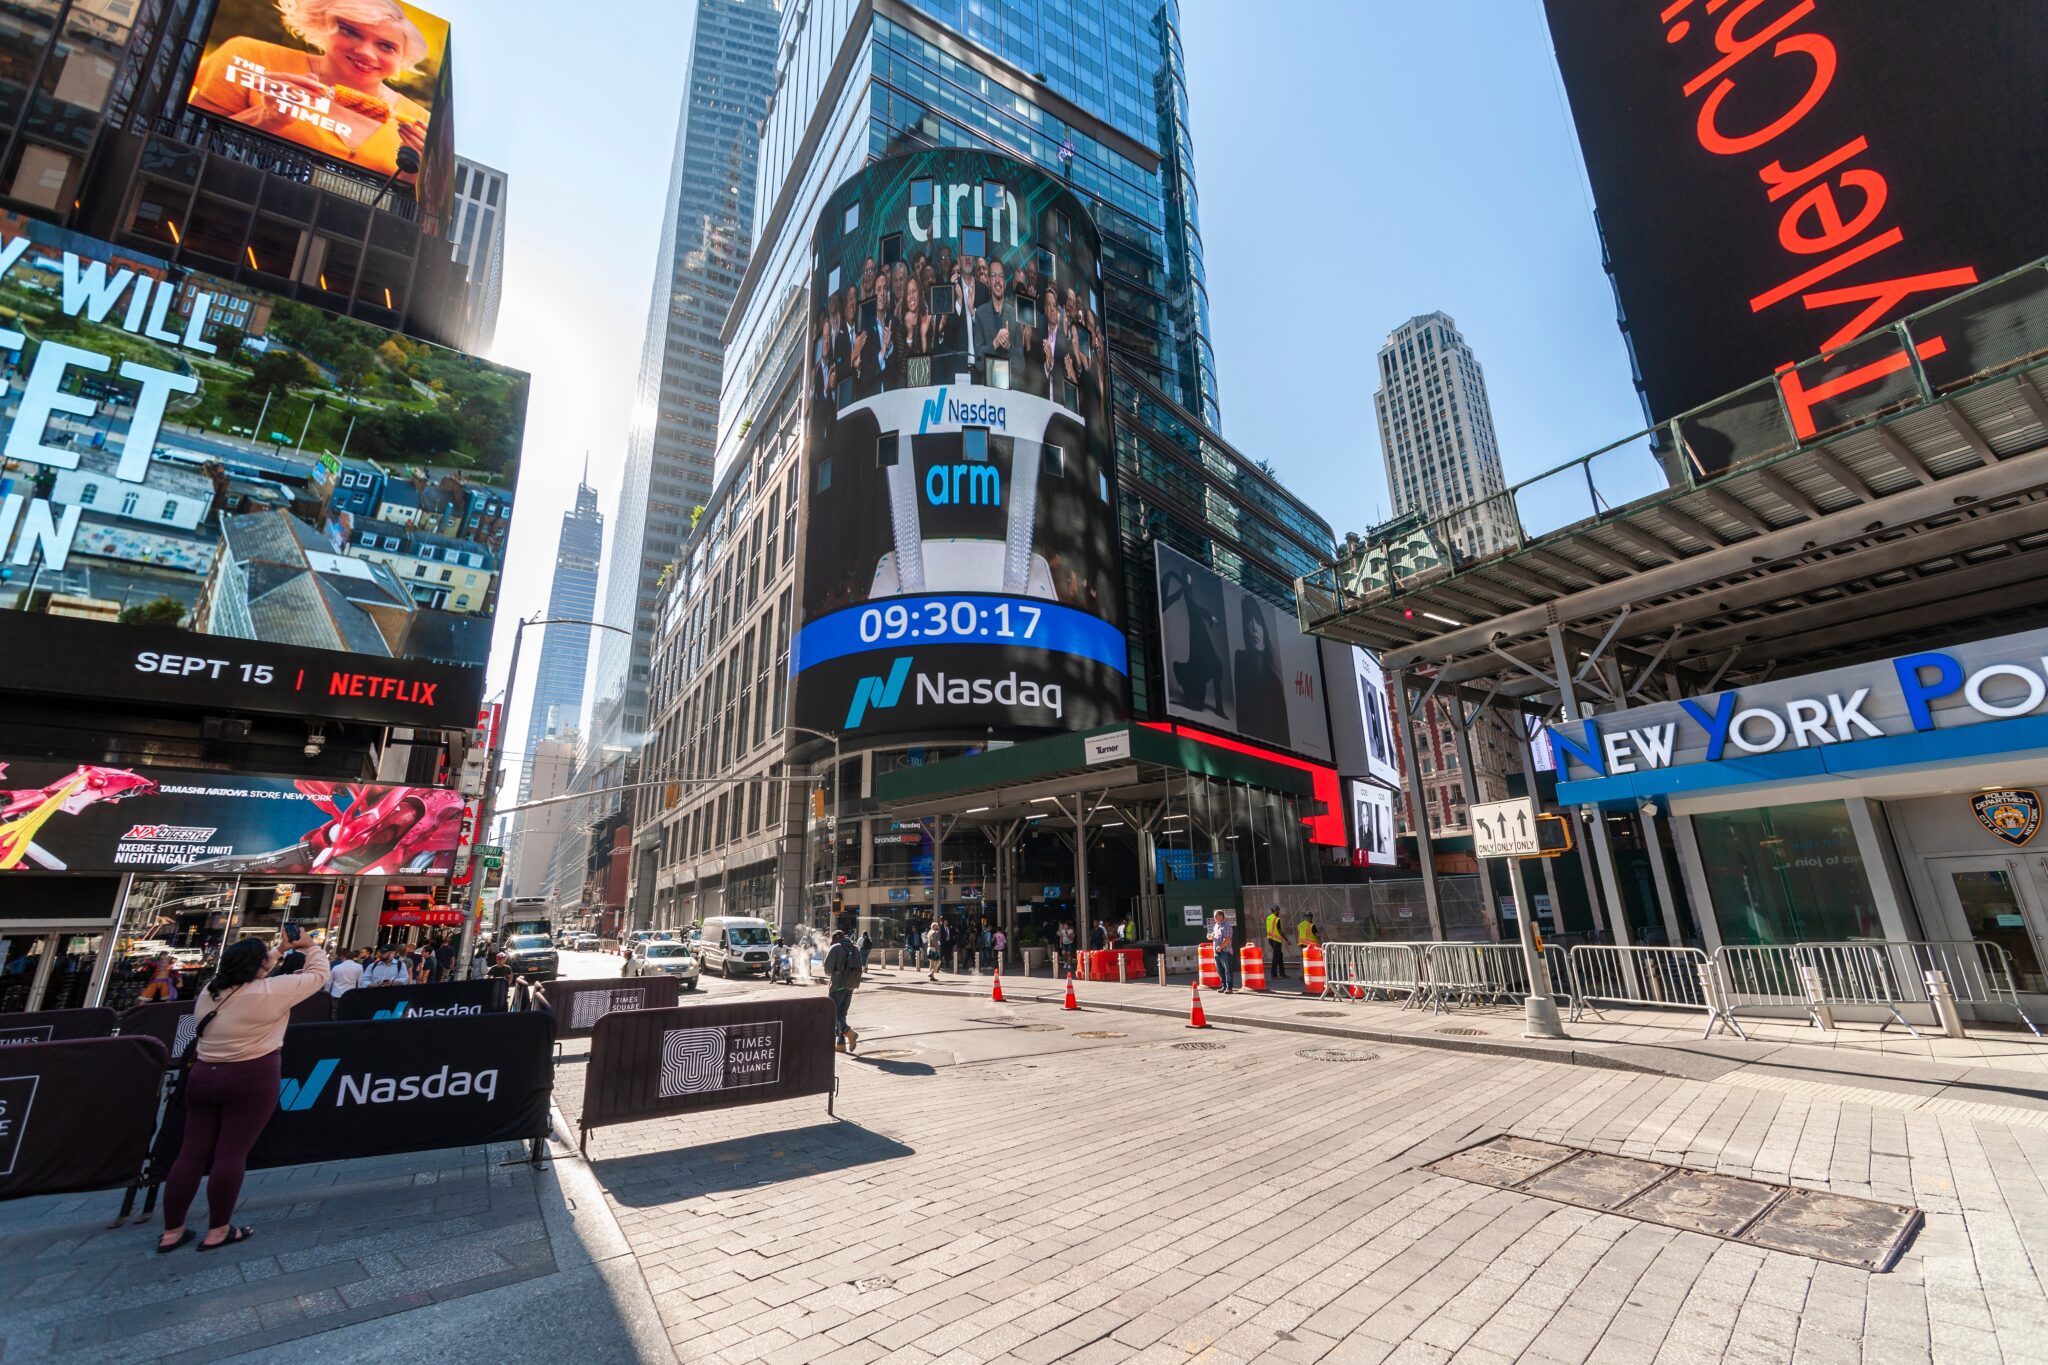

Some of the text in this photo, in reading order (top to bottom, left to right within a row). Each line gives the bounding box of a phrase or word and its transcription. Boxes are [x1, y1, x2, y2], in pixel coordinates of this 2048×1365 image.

[232, 55, 266, 75] THE
[225, 64, 332, 114] FIRST
[275, 98, 353, 138] TIMER
[908, 183, 1019, 248] arm
[1750, 134, 1978, 439] Tyler
[63, 251, 218, 354] WILL
[948, 398, 1006, 431] Nasdaq
[926, 464, 1000, 507] arm
[859, 601, 1042, 643] 09:30:17
[134, 651, 438, 706] SEPT 15 NETFLIX
[1294, 668, 1314, 701] H&M
[916, 671, 1063, 719] Nasdaq
[1548, 718, 1679, 783] NEW
[1678, 687, 1886, 762] YORK
[1892, 652, 2048, 731] PO
[1096, 745, 1118, 755] Turner
[159, 785, 333, 802] TAMASHII NATIONS STORE NEW YORK
[1984, 791, 2018, 800] POLICE
[1975, 797, 2034, 810] DEPARTMENT
[899, 822, 921, 830] Nasdaq
[1979, 814, 2005, 836] CITY OF
[2024, 823, 2035, 836] NEW
[874, 835, 902, 844] branded
[1496, 842, 1514, 852] ONLY
[1516, 841, 1535, 850] ONLY
[118, 843, 156, 853] NXEDGE
[158, 845, 187, 854] STYLE
[1478, 844, 1494, 854] ONLY
[114, 853, 197, 865] NIGHTINGALE
[612, 1002, 640, 1011] SQUARE
[615, 996, 638, 1004] TIMES
[408, 1003, 482, 1018] Nasdaq
[734, 1035, 772, 1048] TIMES
[729, 1048, 775, 1063] SQUARE
[731, 1062, 772, 1074] ALLIANCE
[335, 1065, 498, 1107] Nasdaq
